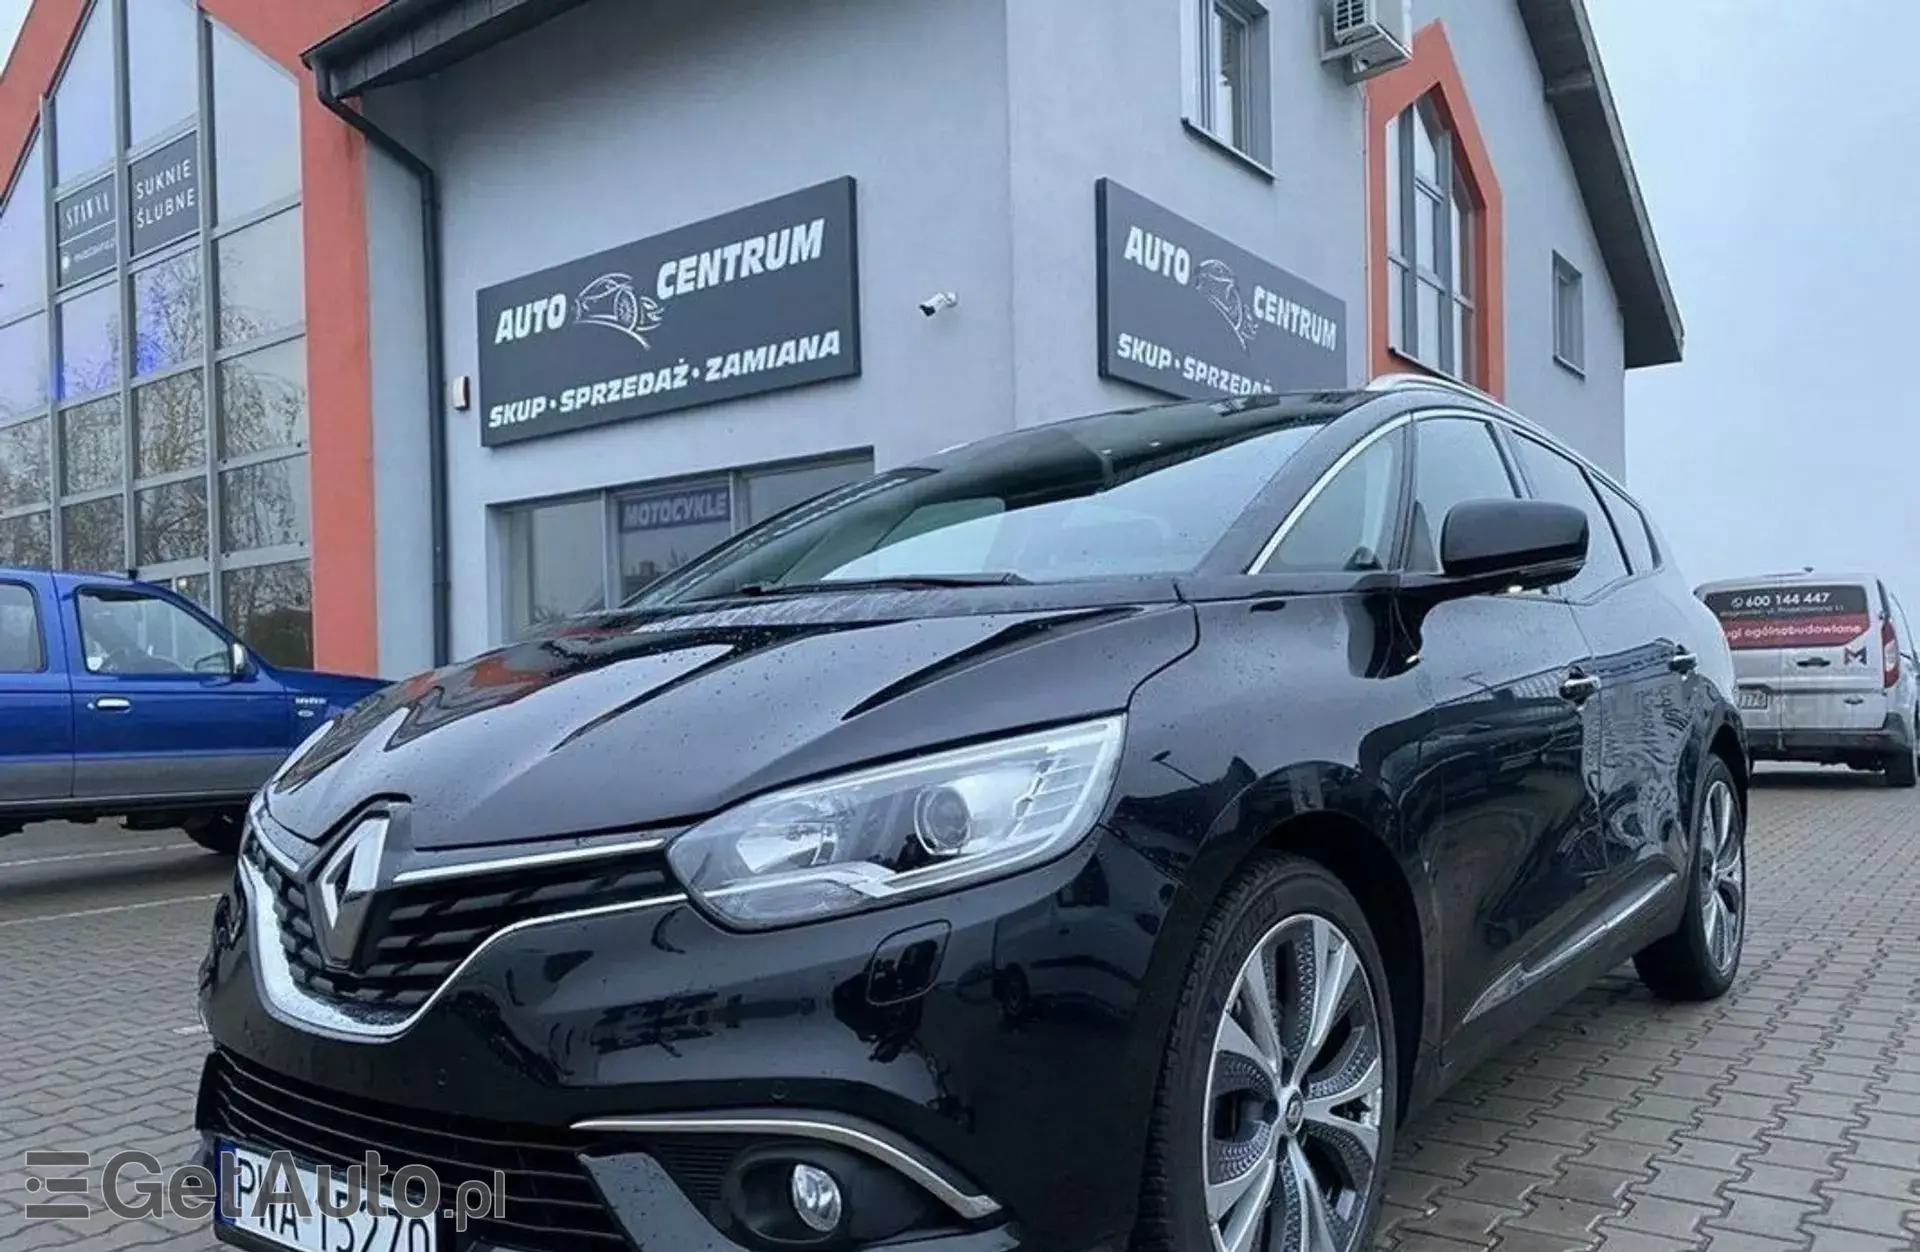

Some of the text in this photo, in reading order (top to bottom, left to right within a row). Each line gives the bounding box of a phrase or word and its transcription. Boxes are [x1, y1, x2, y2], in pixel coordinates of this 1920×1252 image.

[136, 158, 192, 200] SUKNIE
[136, 188, 195, 229] ŚLUBNE
[494, 218, 825, 345] AUTO CENTRUM
[1124, 225, 1337, 351] AUTO CENTRUM
[1117, 332, 1172, 370] SKUP
[489, 329, 841, 428] SKUP SPRZEDAŻ ZAMIANA
[623, 490, 728, 526] MOTOCYKLE
[1745, 595, 1770, 607] 600
[1802, 592, 1831, 604] 447
